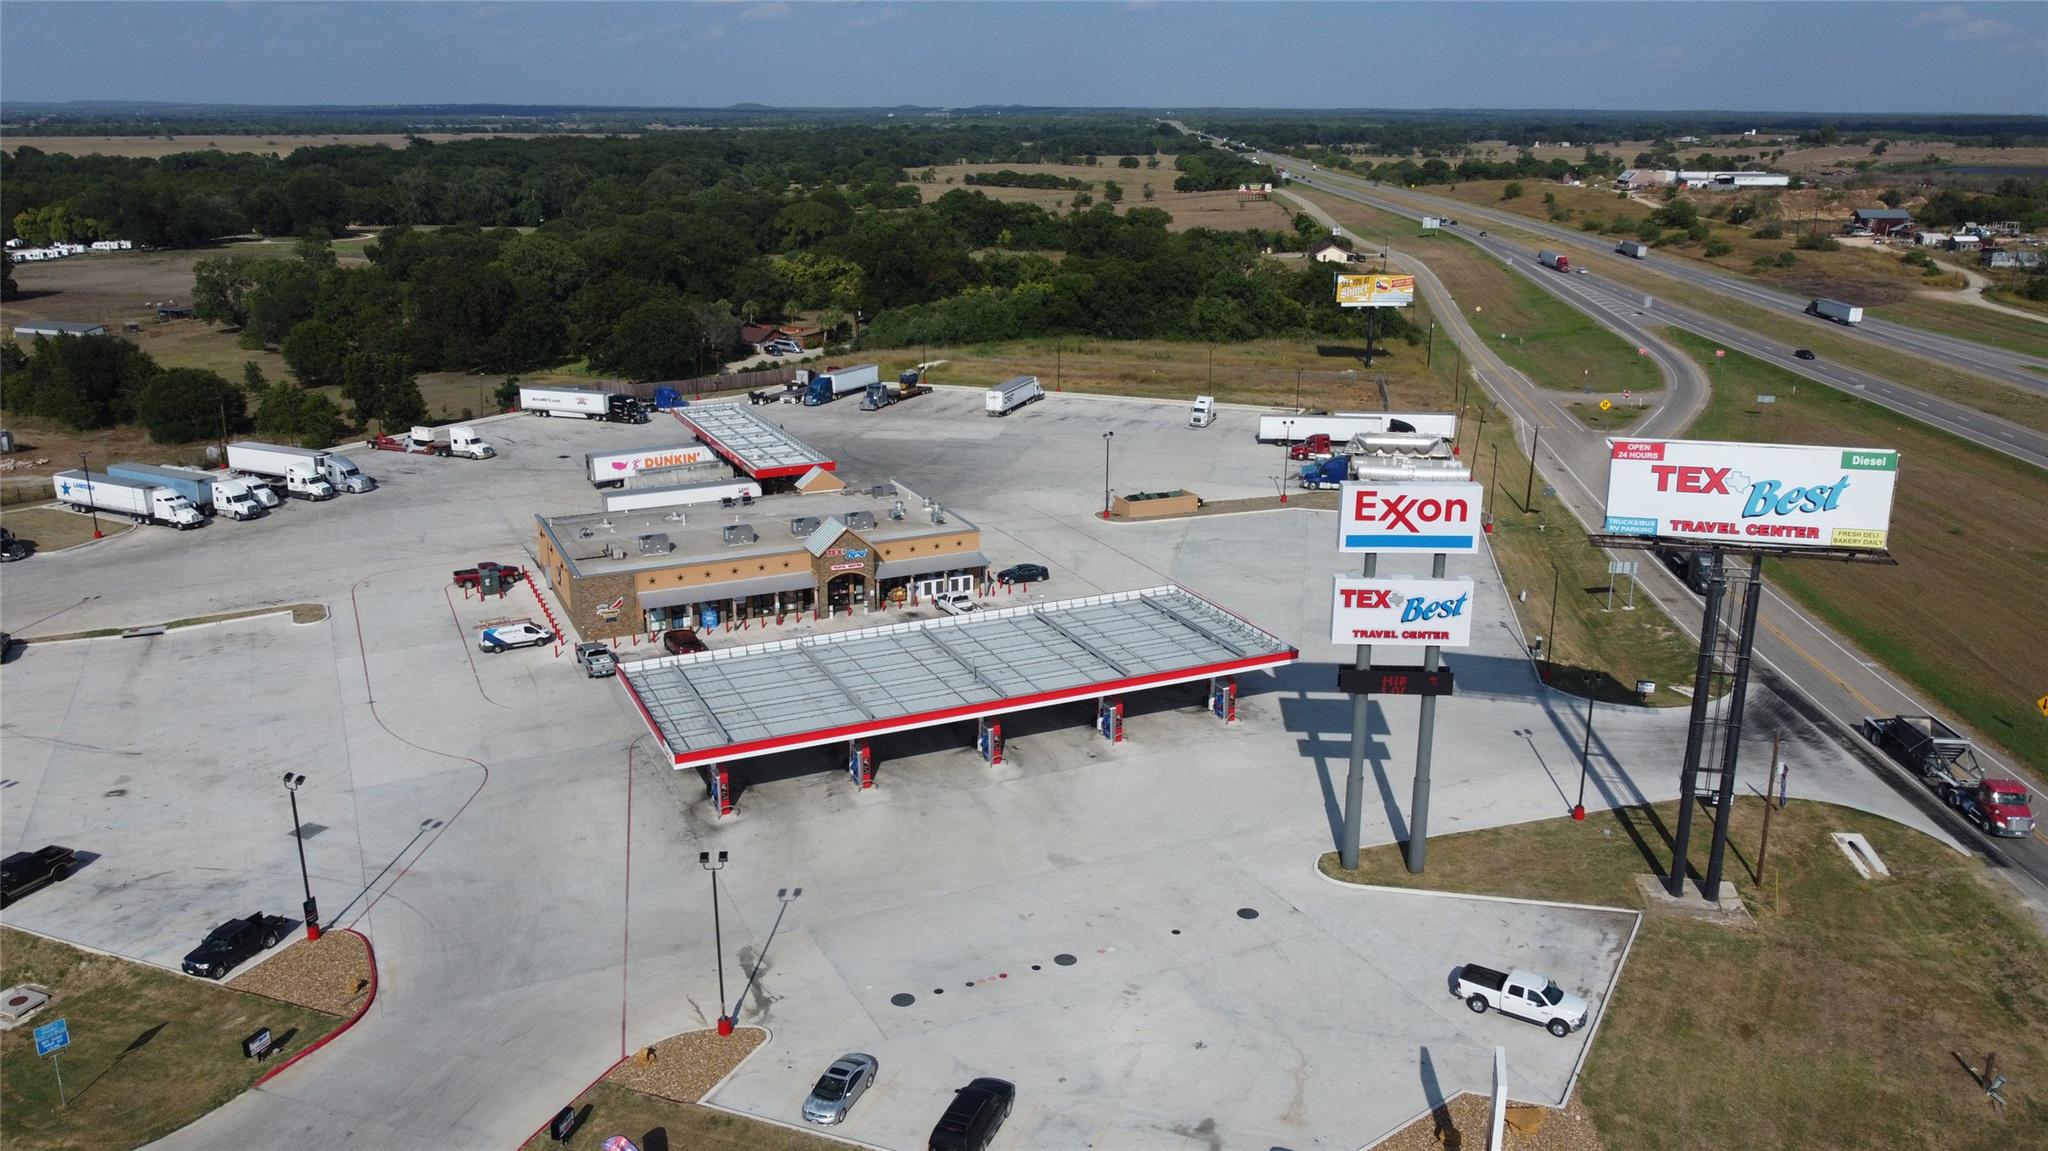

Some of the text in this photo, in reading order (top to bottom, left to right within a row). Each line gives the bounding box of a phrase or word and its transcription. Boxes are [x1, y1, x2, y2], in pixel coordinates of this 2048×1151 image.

[1627, 443, 1651, 451] OPEN
[644, 452, 700, 469] DUNKIN'
[1629, 452, 1659, 460] HOURS
[1852, 455, 1887, 466] Diesel
[1651, 465, 1851, 518] TEX Best
[1354, 490, 1469, 533] Exxon
[1621, 526, 1655, 534] PARKING
[1670, 519, 1820, 539] TRAVEL CENTER
[1838, 530, 1880, 539] FRESH DELI
[1340, 589, 1468, 623] TEX Best
[1352, 629, 1449, 640] TRAVEL CENTER
